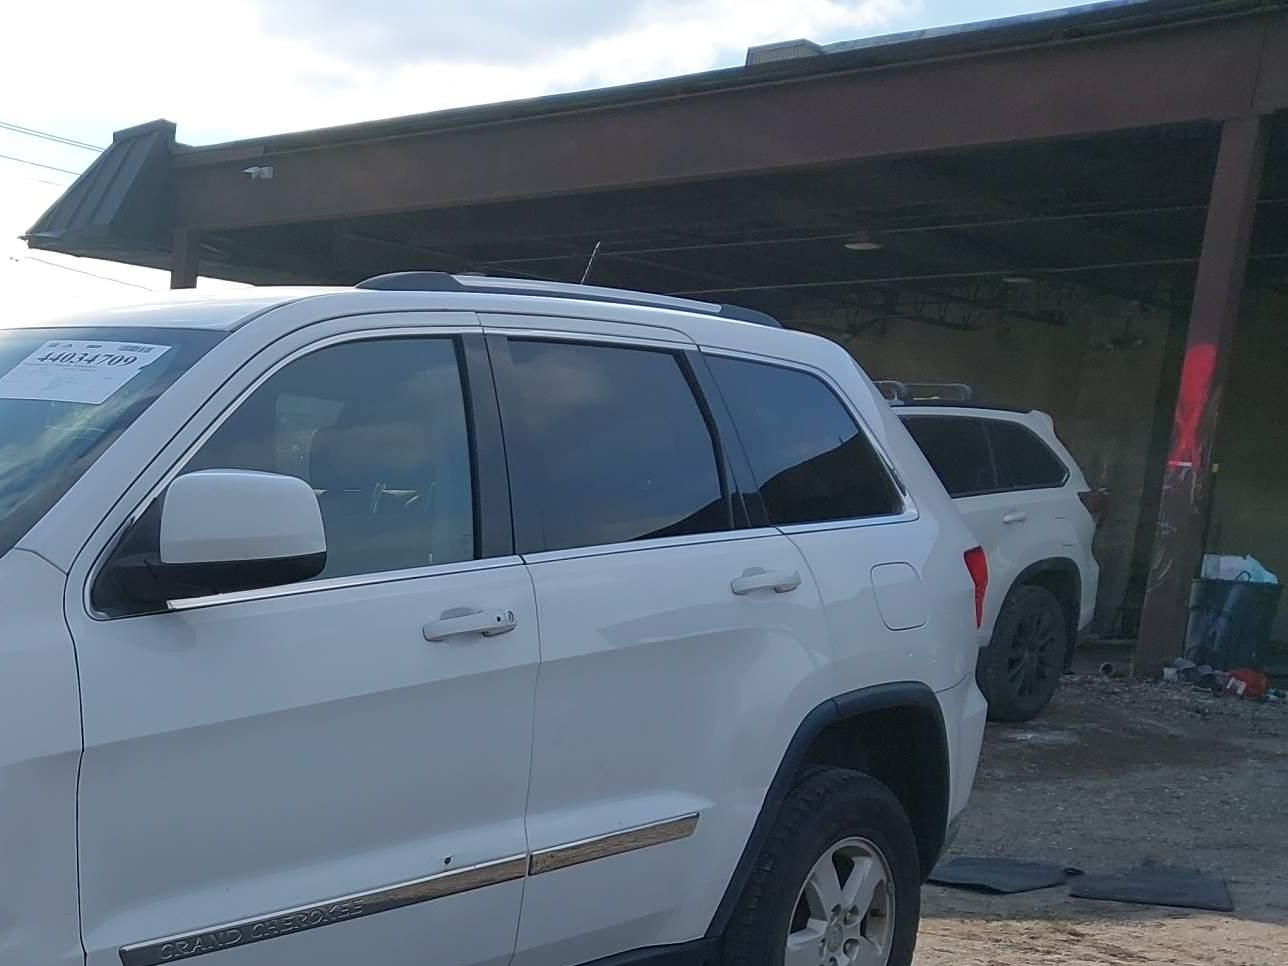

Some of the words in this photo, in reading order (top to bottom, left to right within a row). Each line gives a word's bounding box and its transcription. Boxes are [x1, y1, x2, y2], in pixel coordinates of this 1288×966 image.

[37, 351, 138, 368] 44034709
[160, 928, 243, 961] GRAND
[252, 899, 364, 938] CHEROKEE
